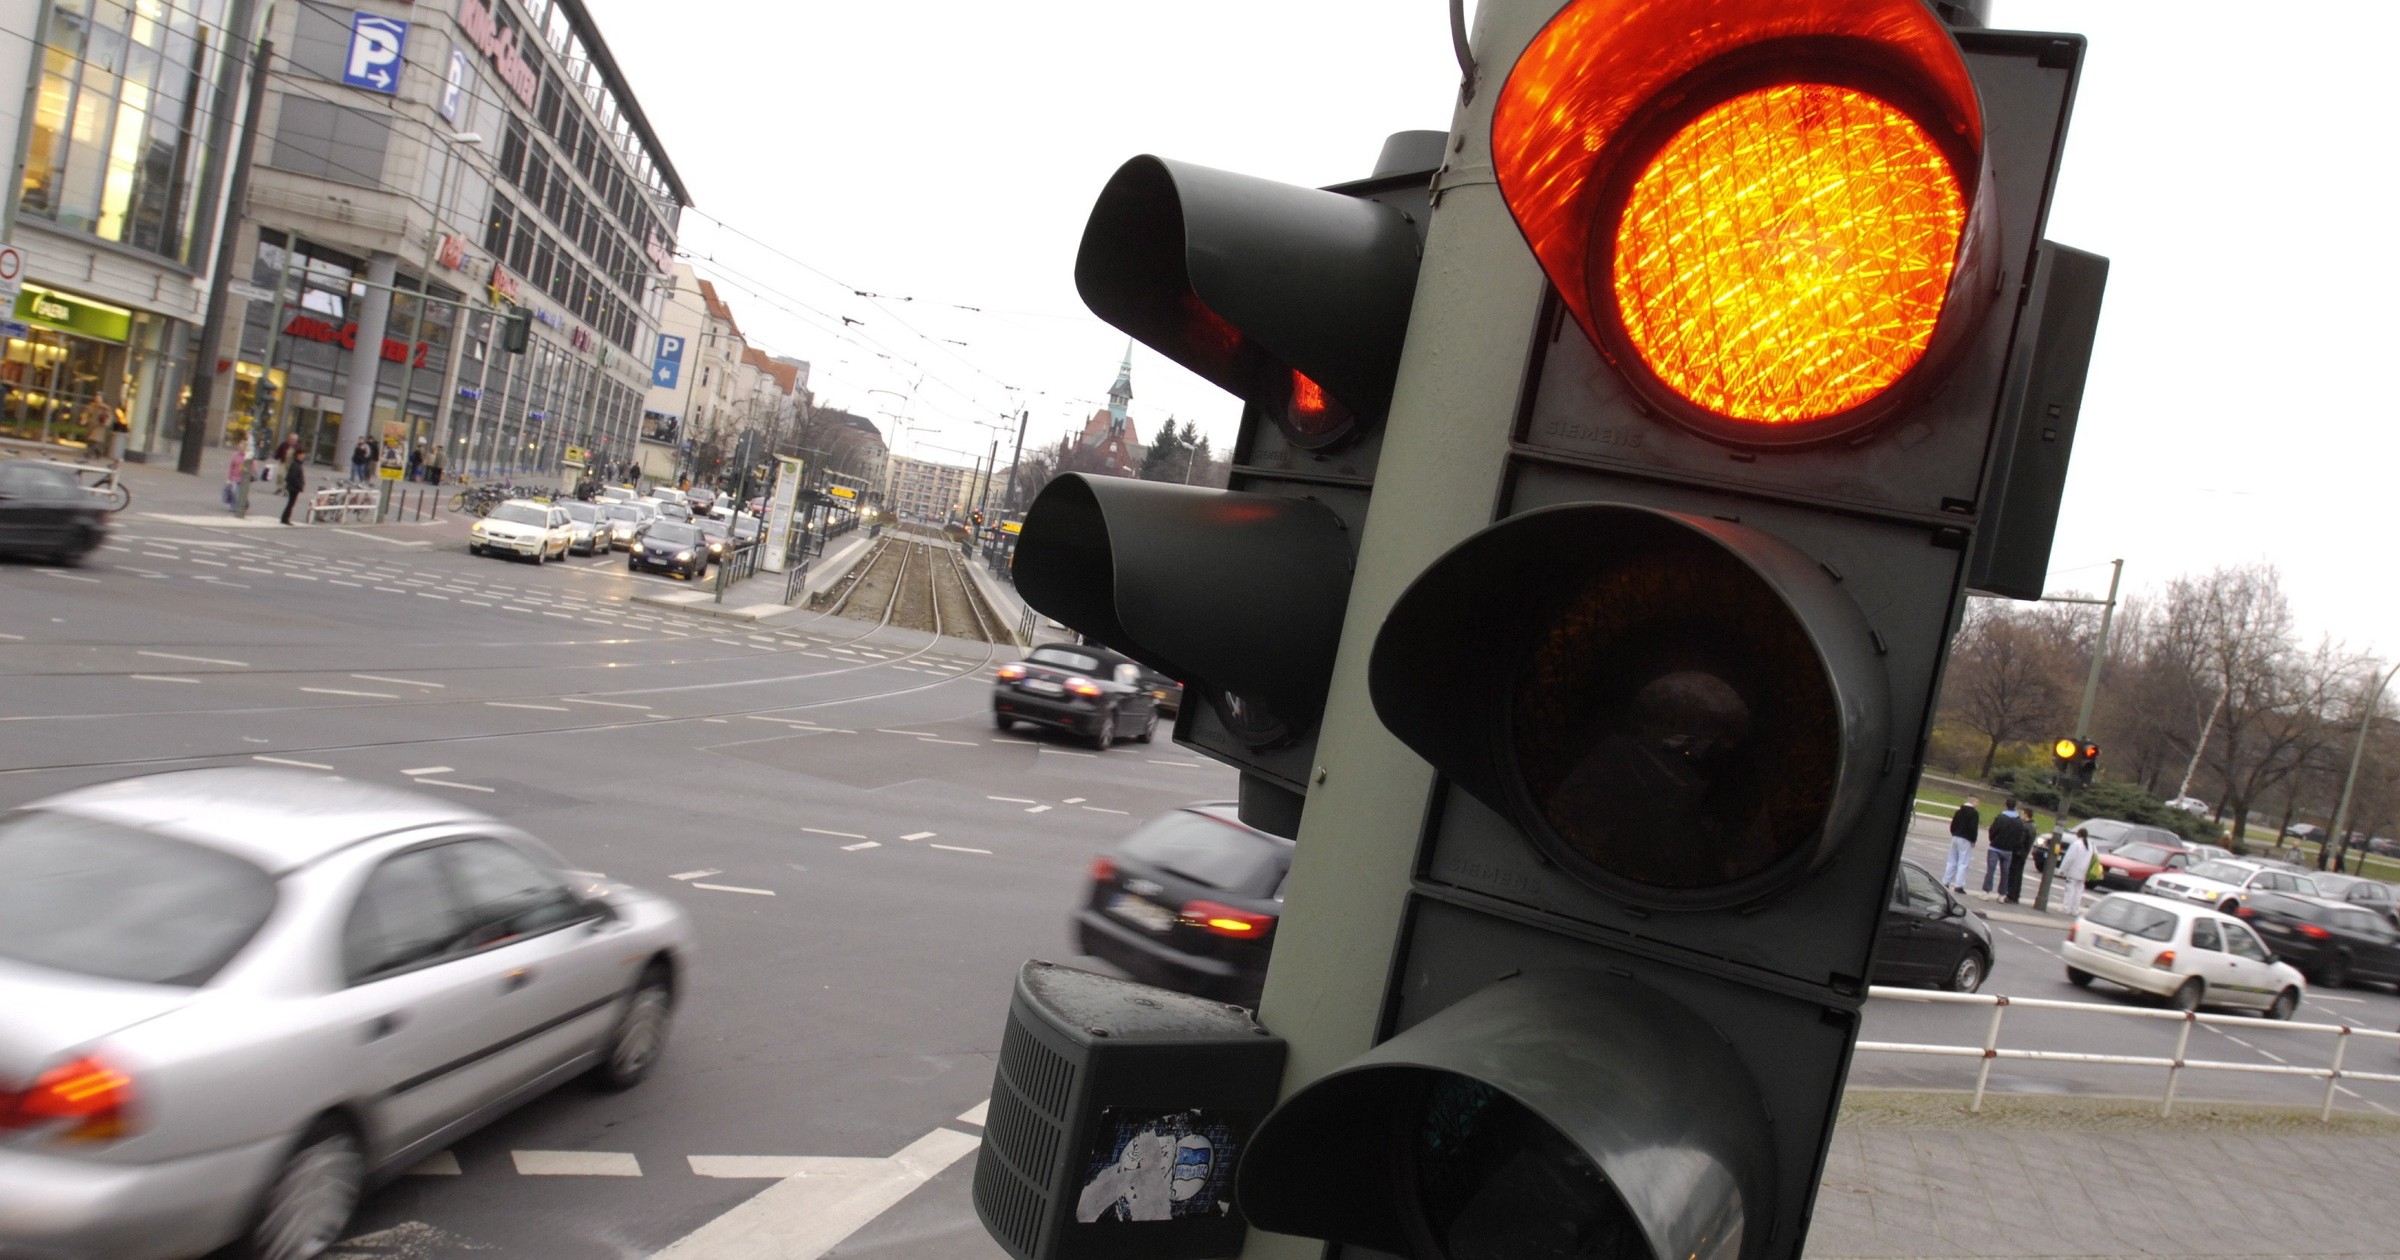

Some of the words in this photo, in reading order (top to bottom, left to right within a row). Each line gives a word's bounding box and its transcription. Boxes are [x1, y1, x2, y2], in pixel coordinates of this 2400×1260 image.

[349, 25, 399, 79] P
[661, 337, 679, 357] P
[1545, 421, 1642, 448] SIEMENS
